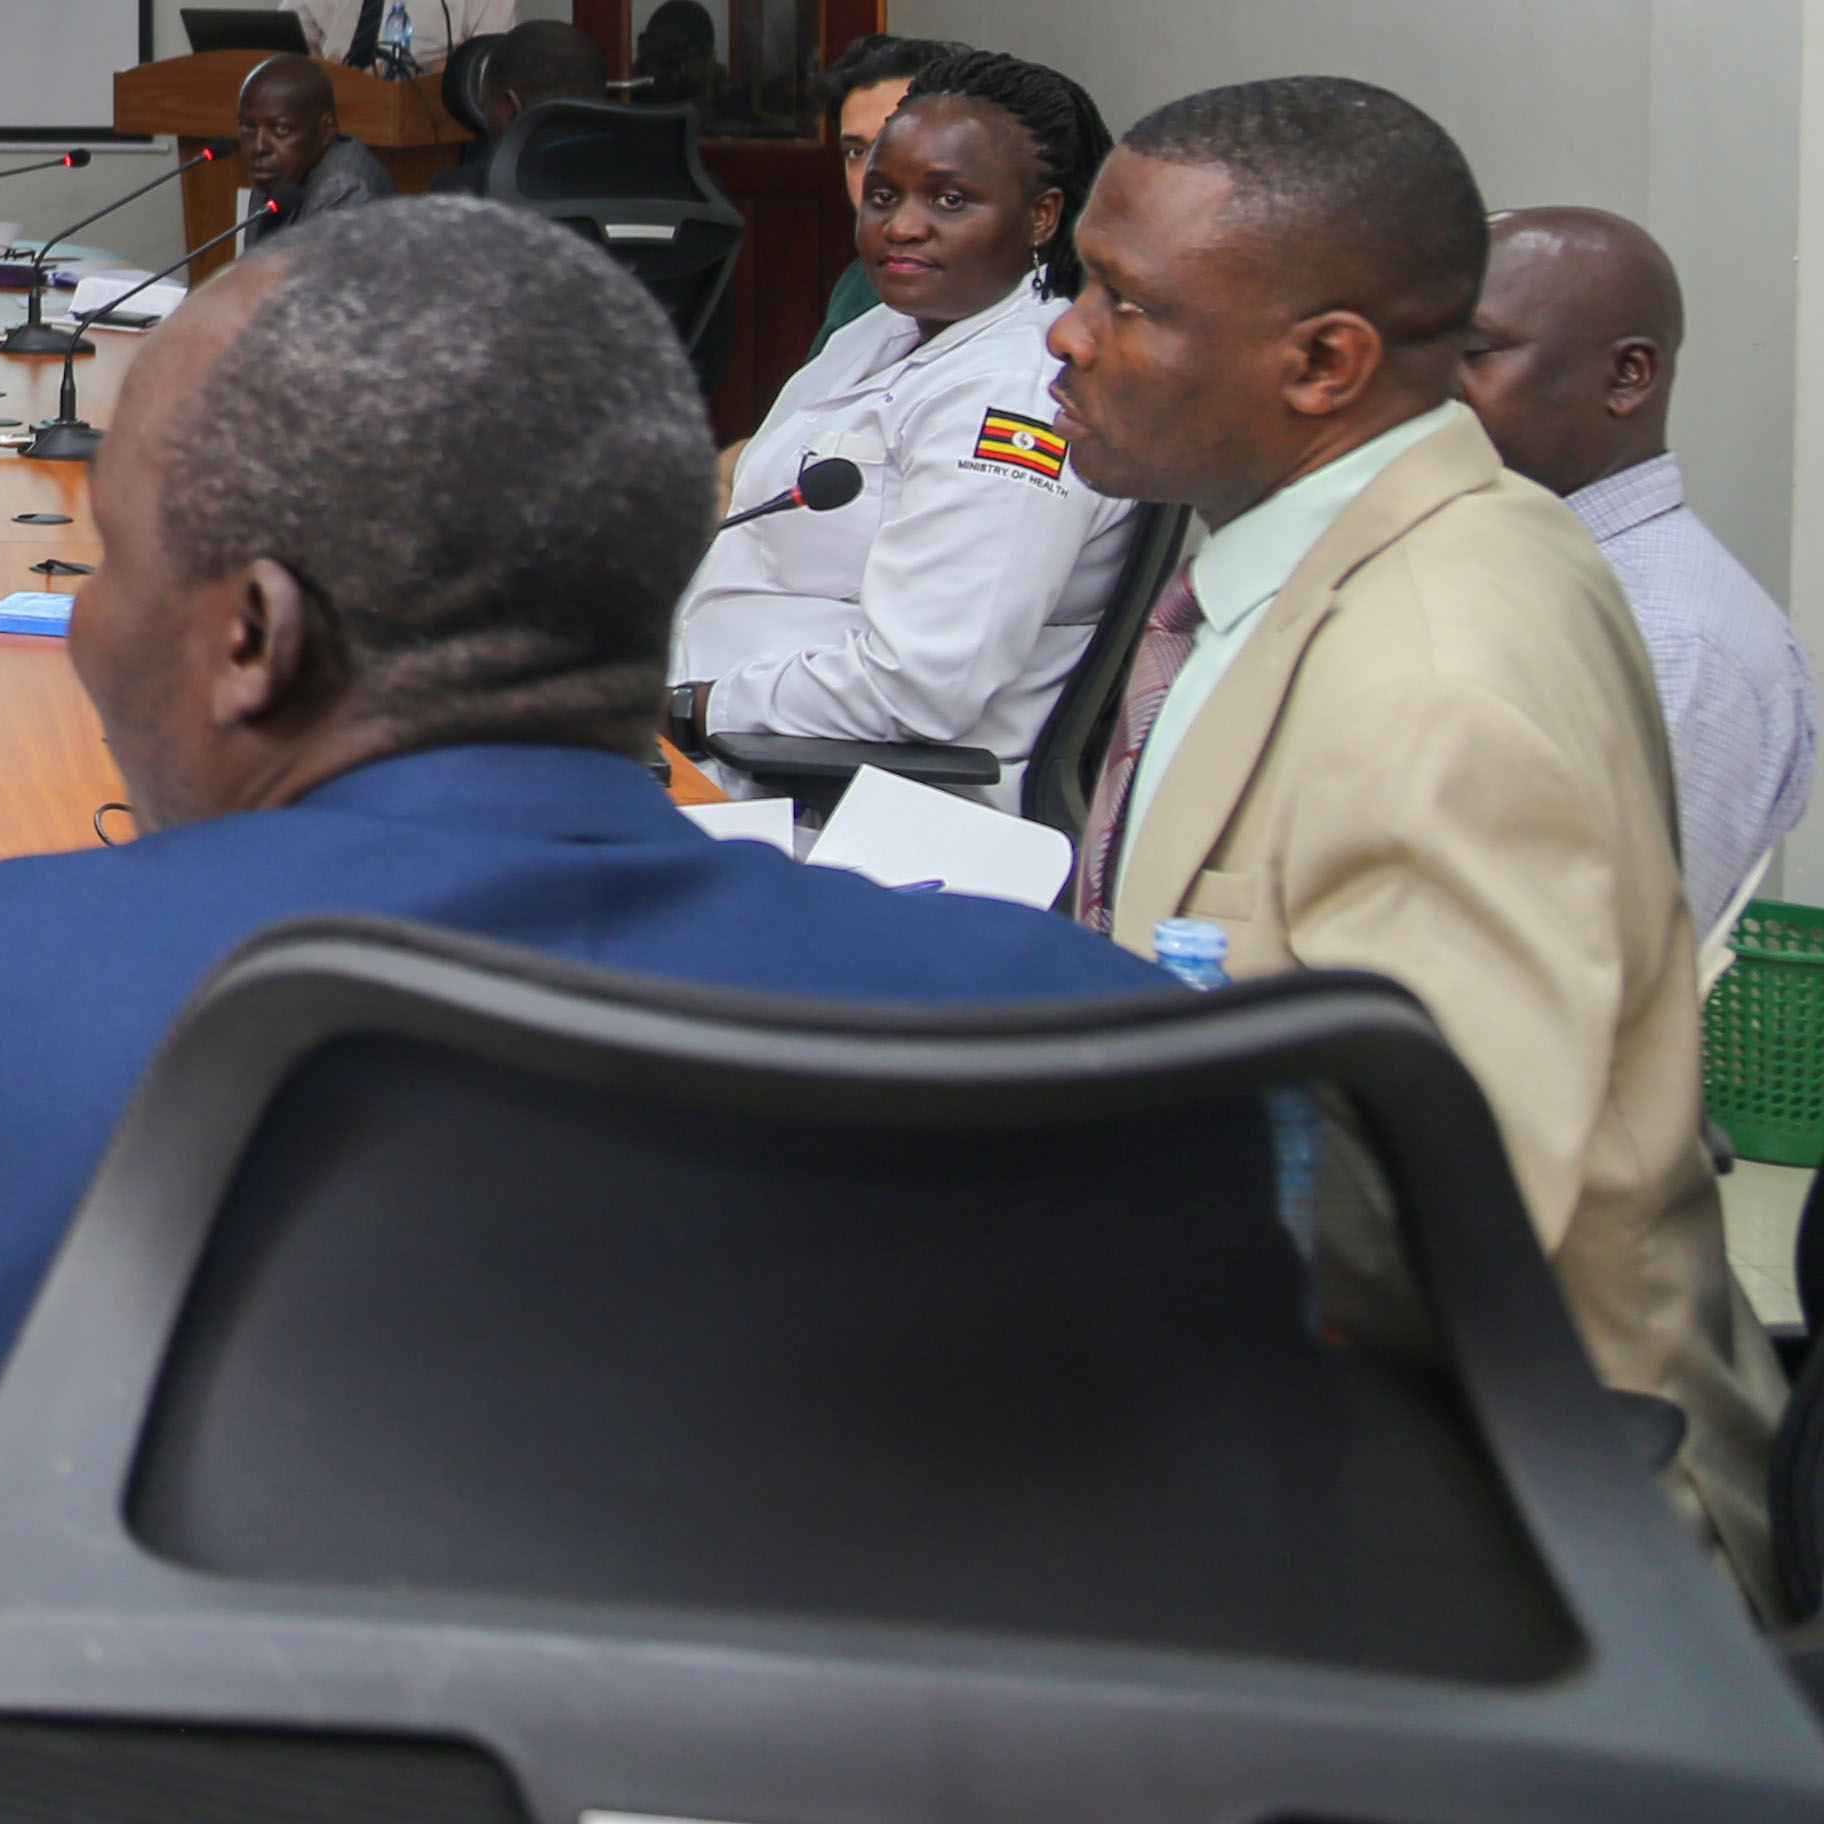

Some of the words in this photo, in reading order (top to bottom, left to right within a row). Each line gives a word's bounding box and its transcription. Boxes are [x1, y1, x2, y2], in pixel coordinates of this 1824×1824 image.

[958, 459, 1008, 478] MINISTRY
[1011, 470, 1026, 481] OF
[1028, 472, 1069, 498] HEALTH
